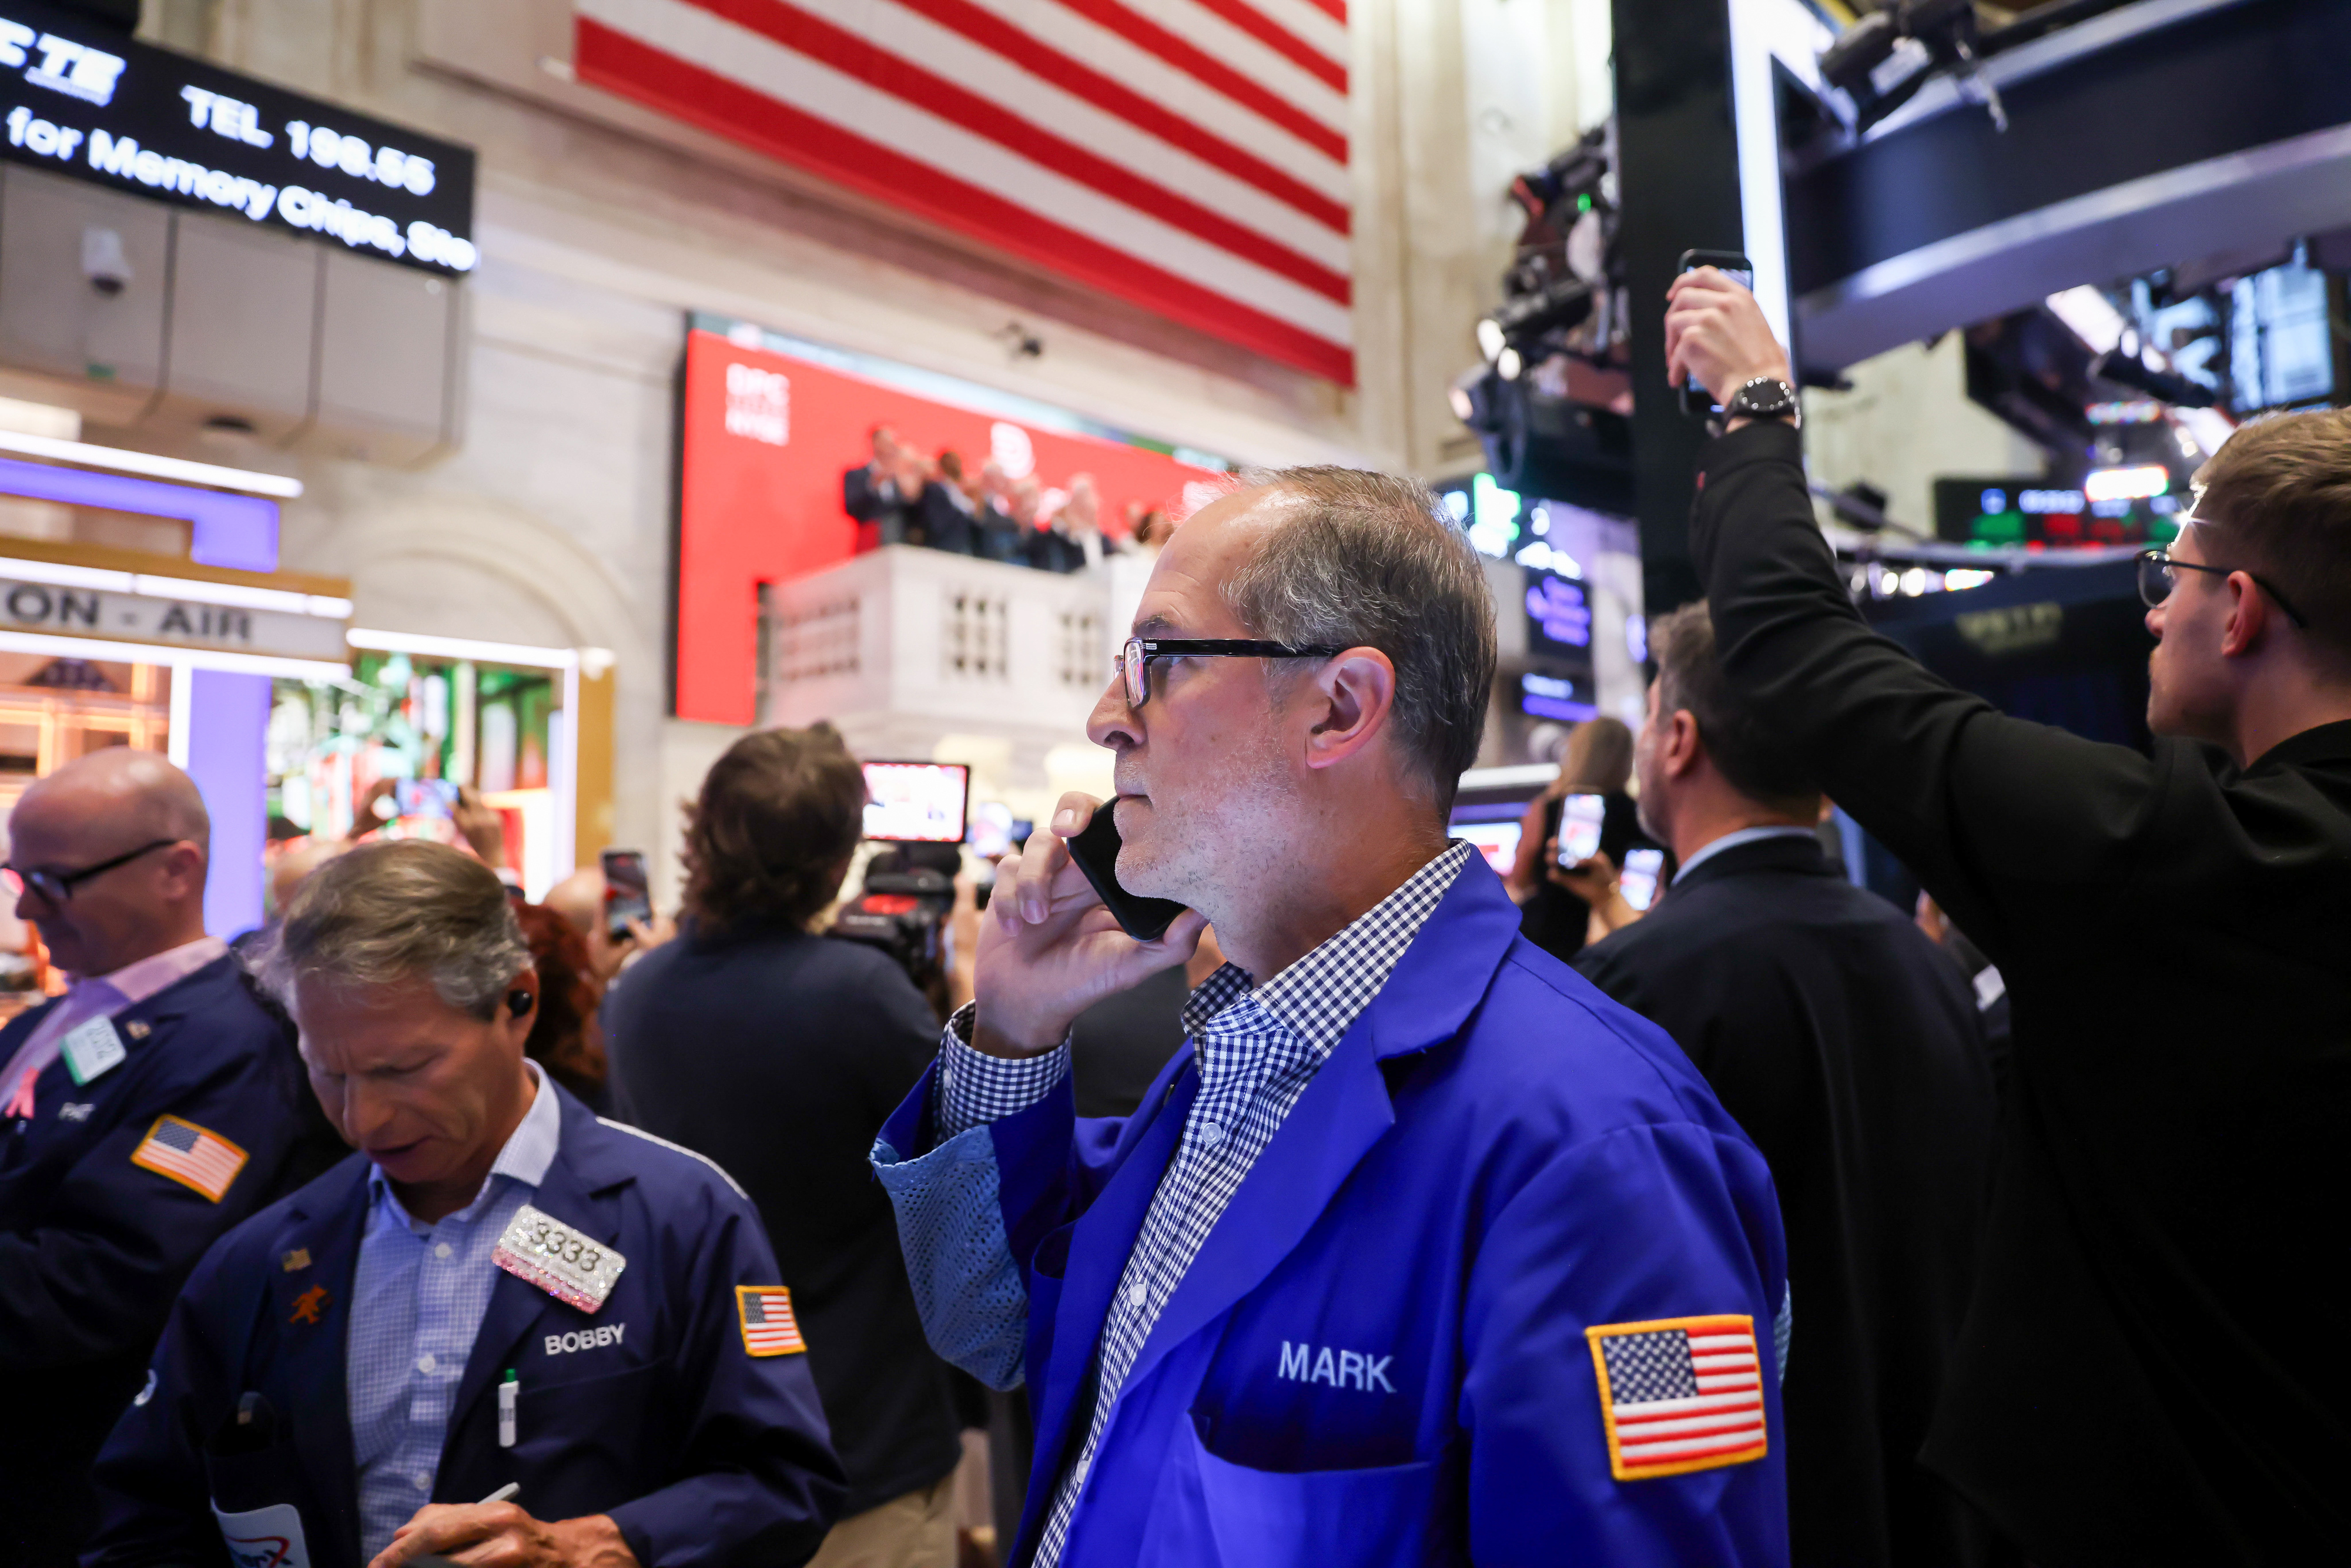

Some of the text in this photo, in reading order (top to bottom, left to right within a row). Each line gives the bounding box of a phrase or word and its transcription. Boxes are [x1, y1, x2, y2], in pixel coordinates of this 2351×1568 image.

[180, 84, 274, 149] TEL
[8, 106, 83, 160] for
[89, 128, 277, 220] Memory
[6, 585, 100, 626] ON
[159, 602, 251, 640] AIR
[544, 1323, 626, 1356] BOBBY
[1278, 1340, 1398, 1393] MARK
